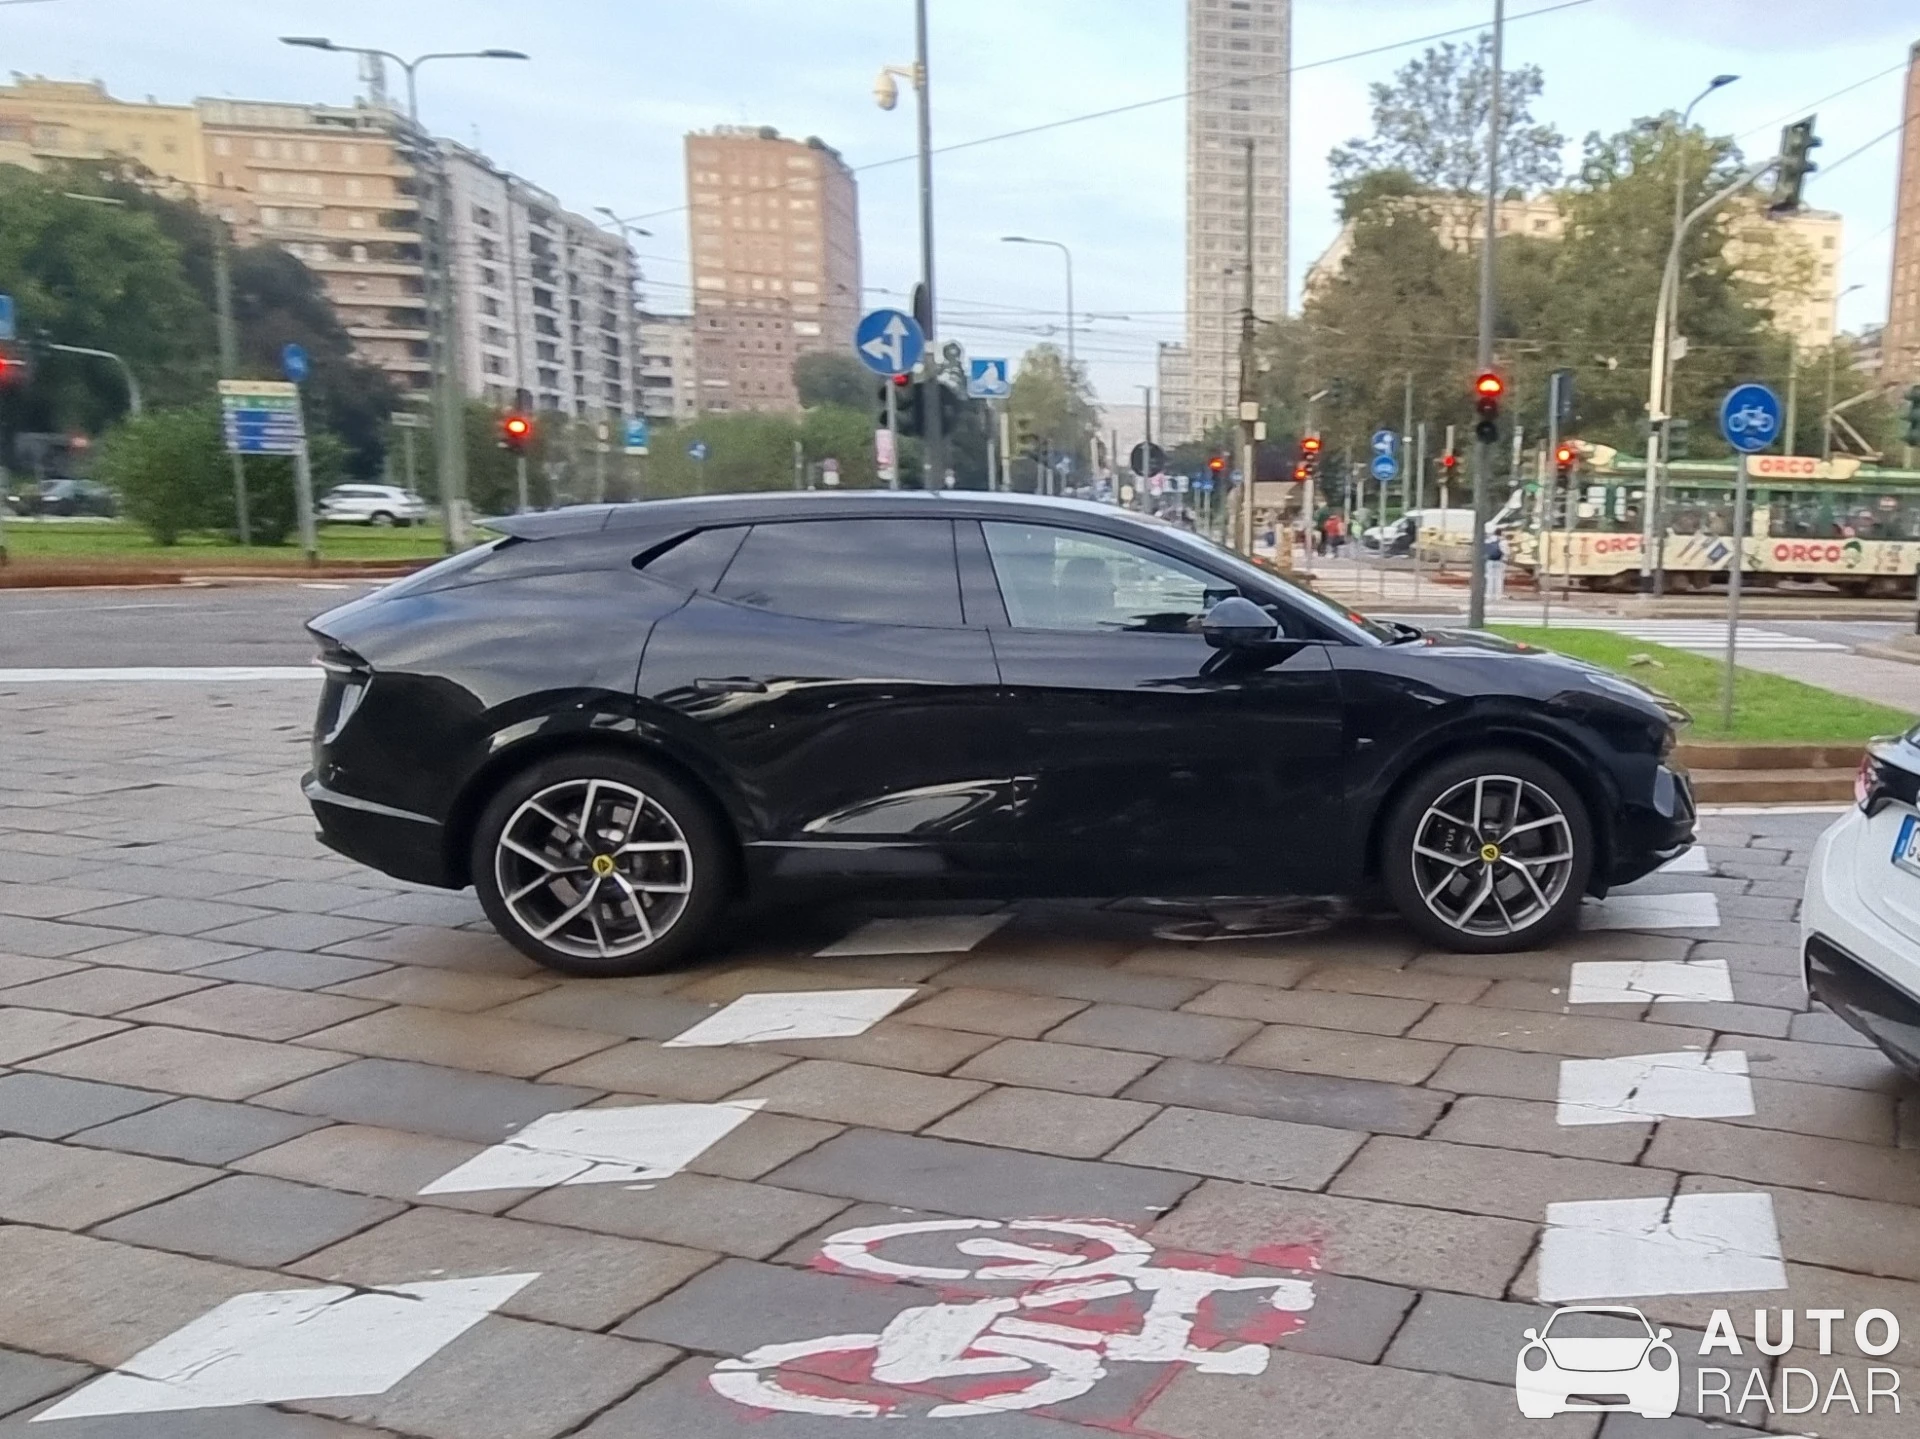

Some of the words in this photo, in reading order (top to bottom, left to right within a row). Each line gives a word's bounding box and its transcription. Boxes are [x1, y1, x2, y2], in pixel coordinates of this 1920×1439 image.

[1760, 459, 1815, 474] ORCO
[1595, 536, 1644, 554] ORC
[1774, 544, 1841, 562] ORCO
